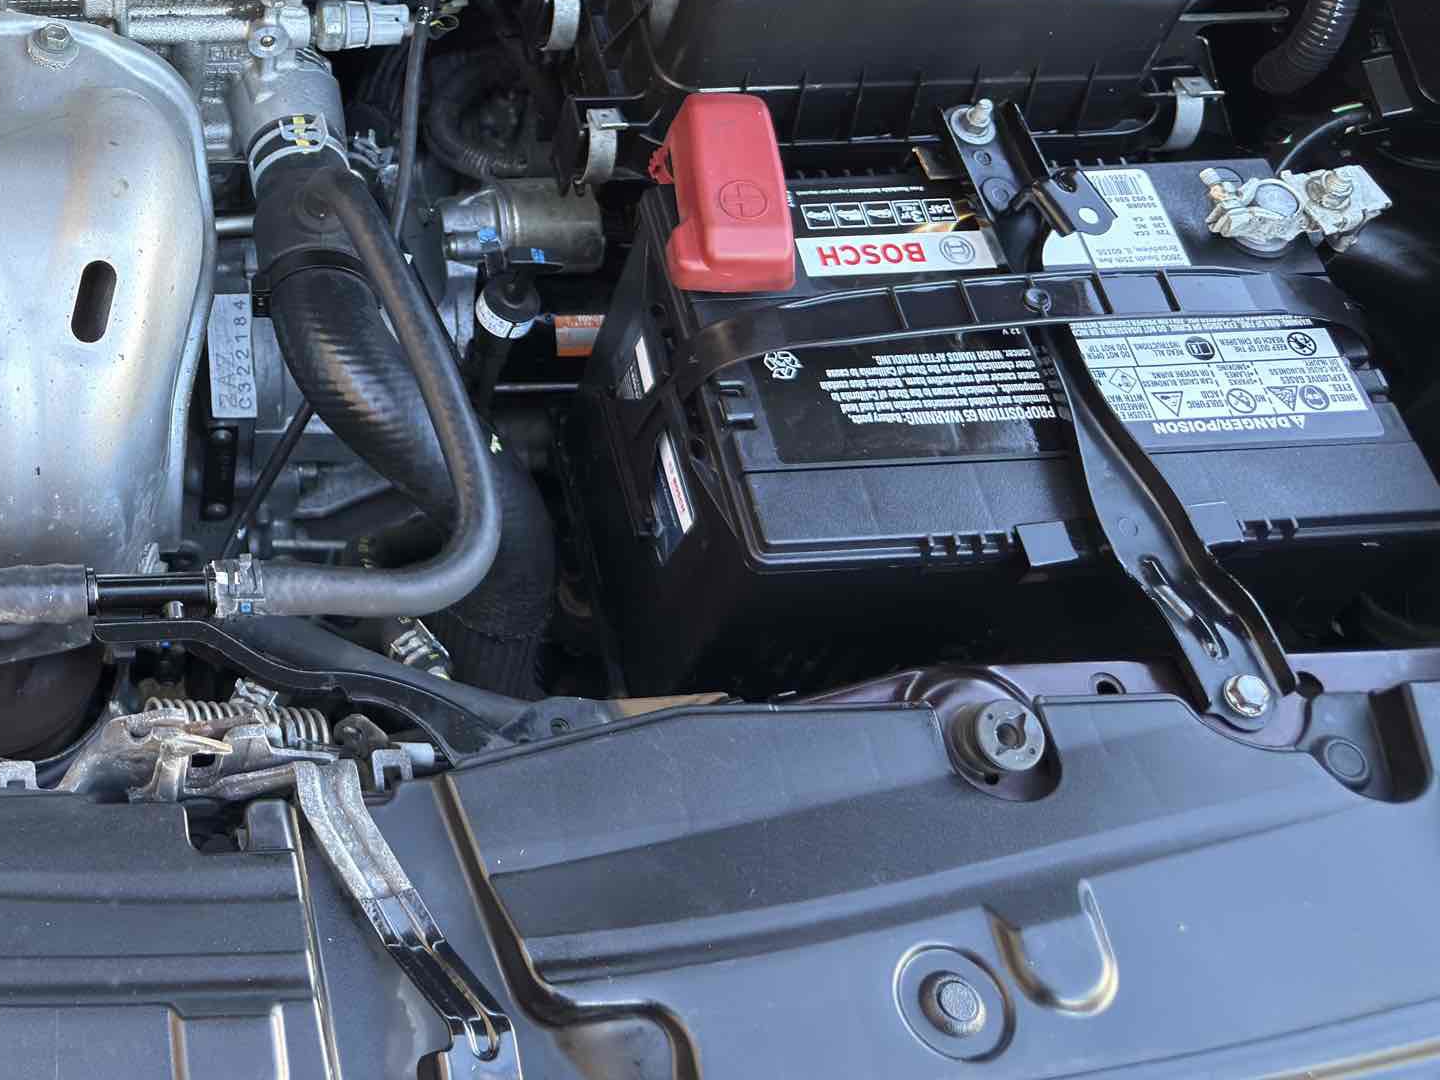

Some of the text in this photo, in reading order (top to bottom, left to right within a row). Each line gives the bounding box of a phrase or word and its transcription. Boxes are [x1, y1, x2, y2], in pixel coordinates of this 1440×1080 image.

[817, 242, 927, 267] BOSCH
[232, 299, 252, 410] C322184
[1329, 394, 1358, 402] SHIELD
[901, 410, 965, 425] WARNING:
[962, 409, 979, 422] 65
[977, 406, 1056, 422] PROPOSITION
[1152, 415, 1292, 433] DANGER/POISON
